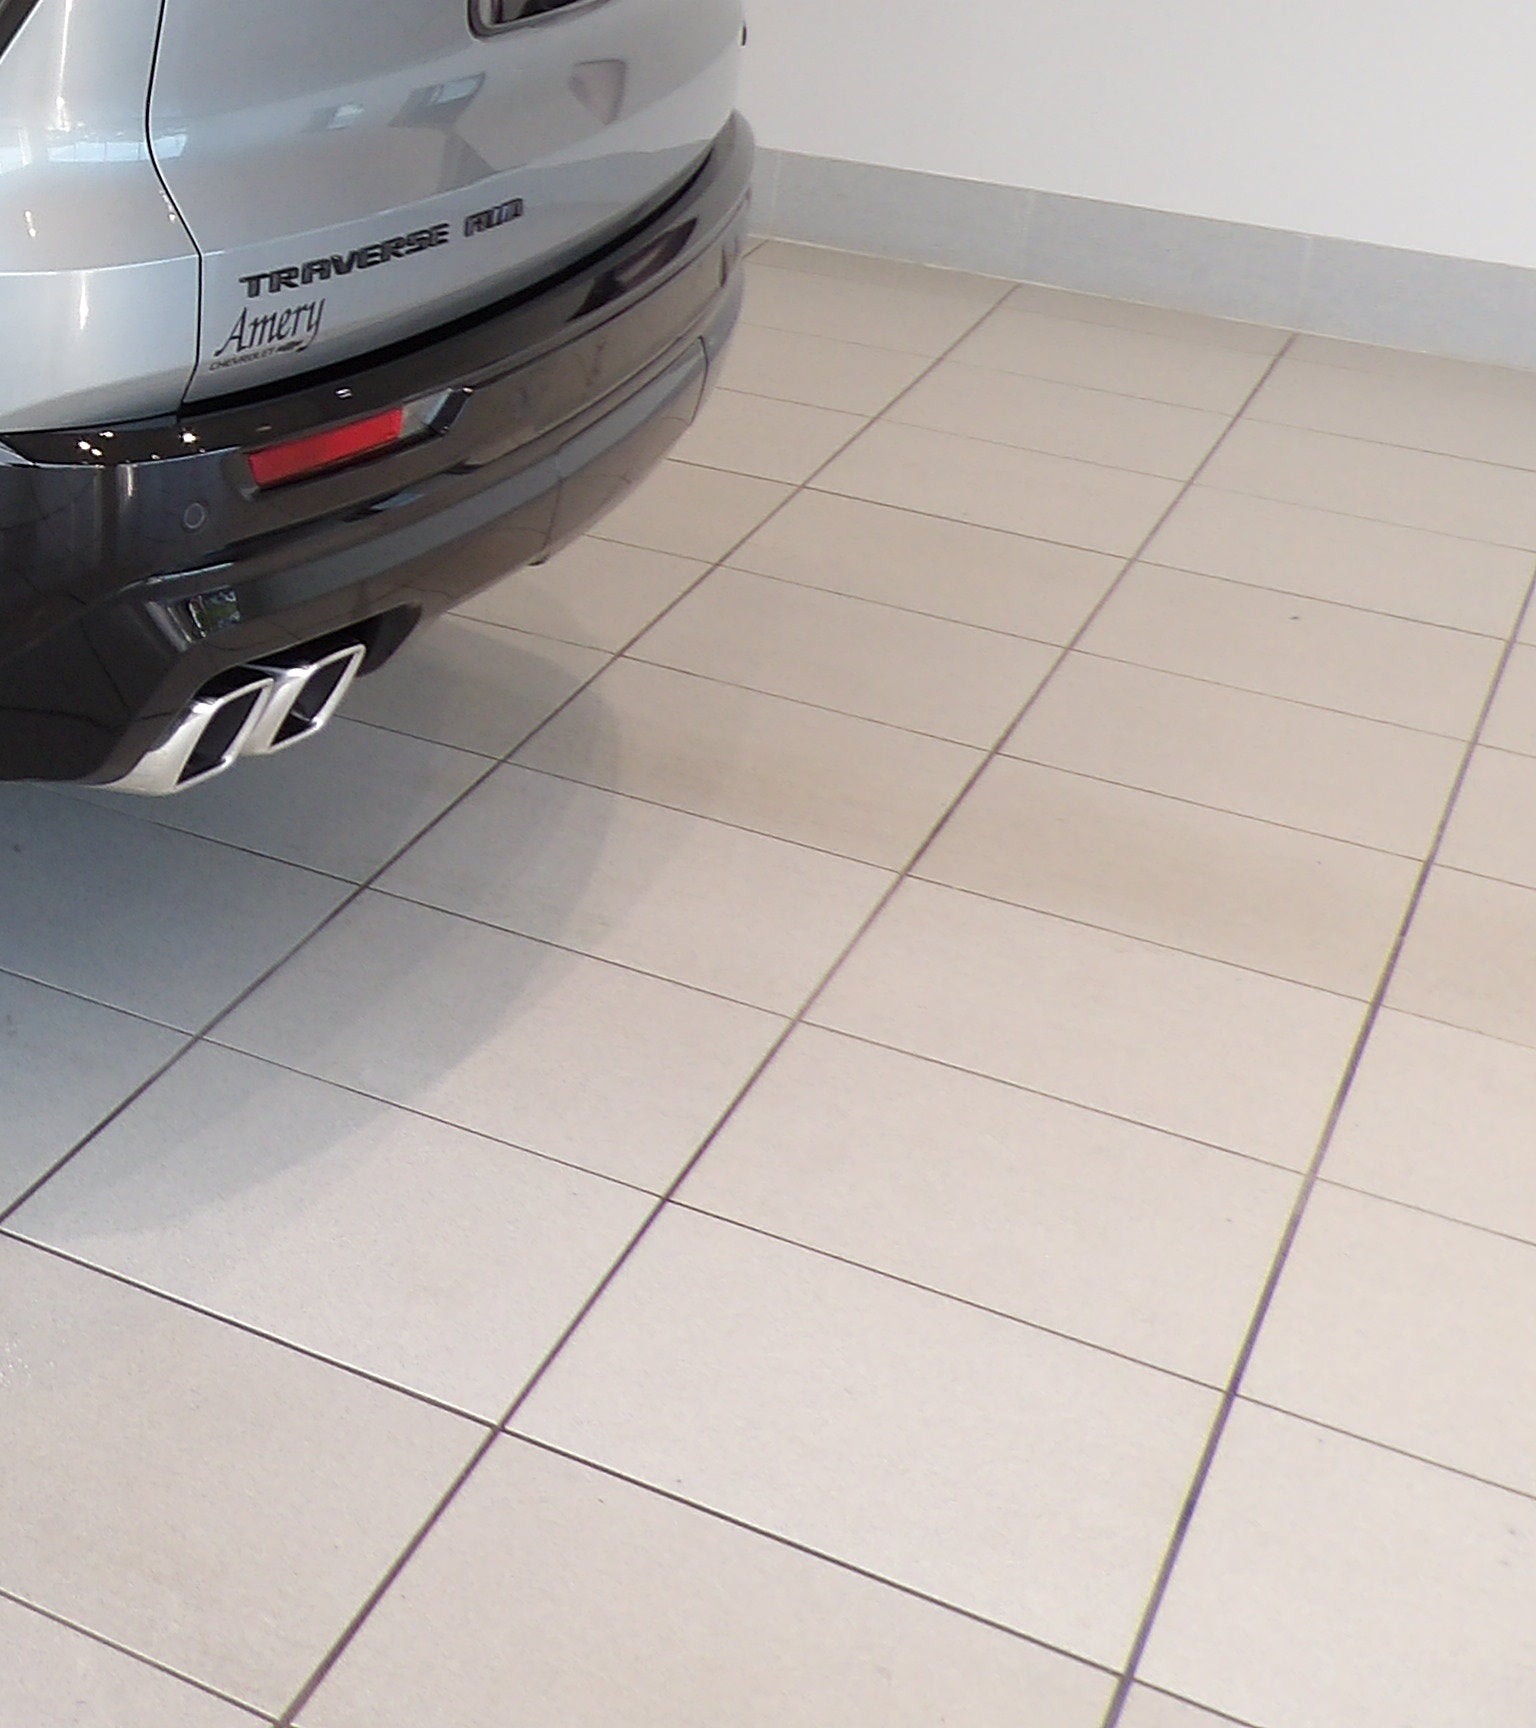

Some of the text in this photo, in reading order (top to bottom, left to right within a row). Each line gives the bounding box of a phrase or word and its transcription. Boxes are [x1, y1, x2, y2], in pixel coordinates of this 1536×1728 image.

[239, 223, 450, 299] TRAVERSE
[214, 298, 326, 357] Amery
[209, 349, 274, 371] CHEVROLET
